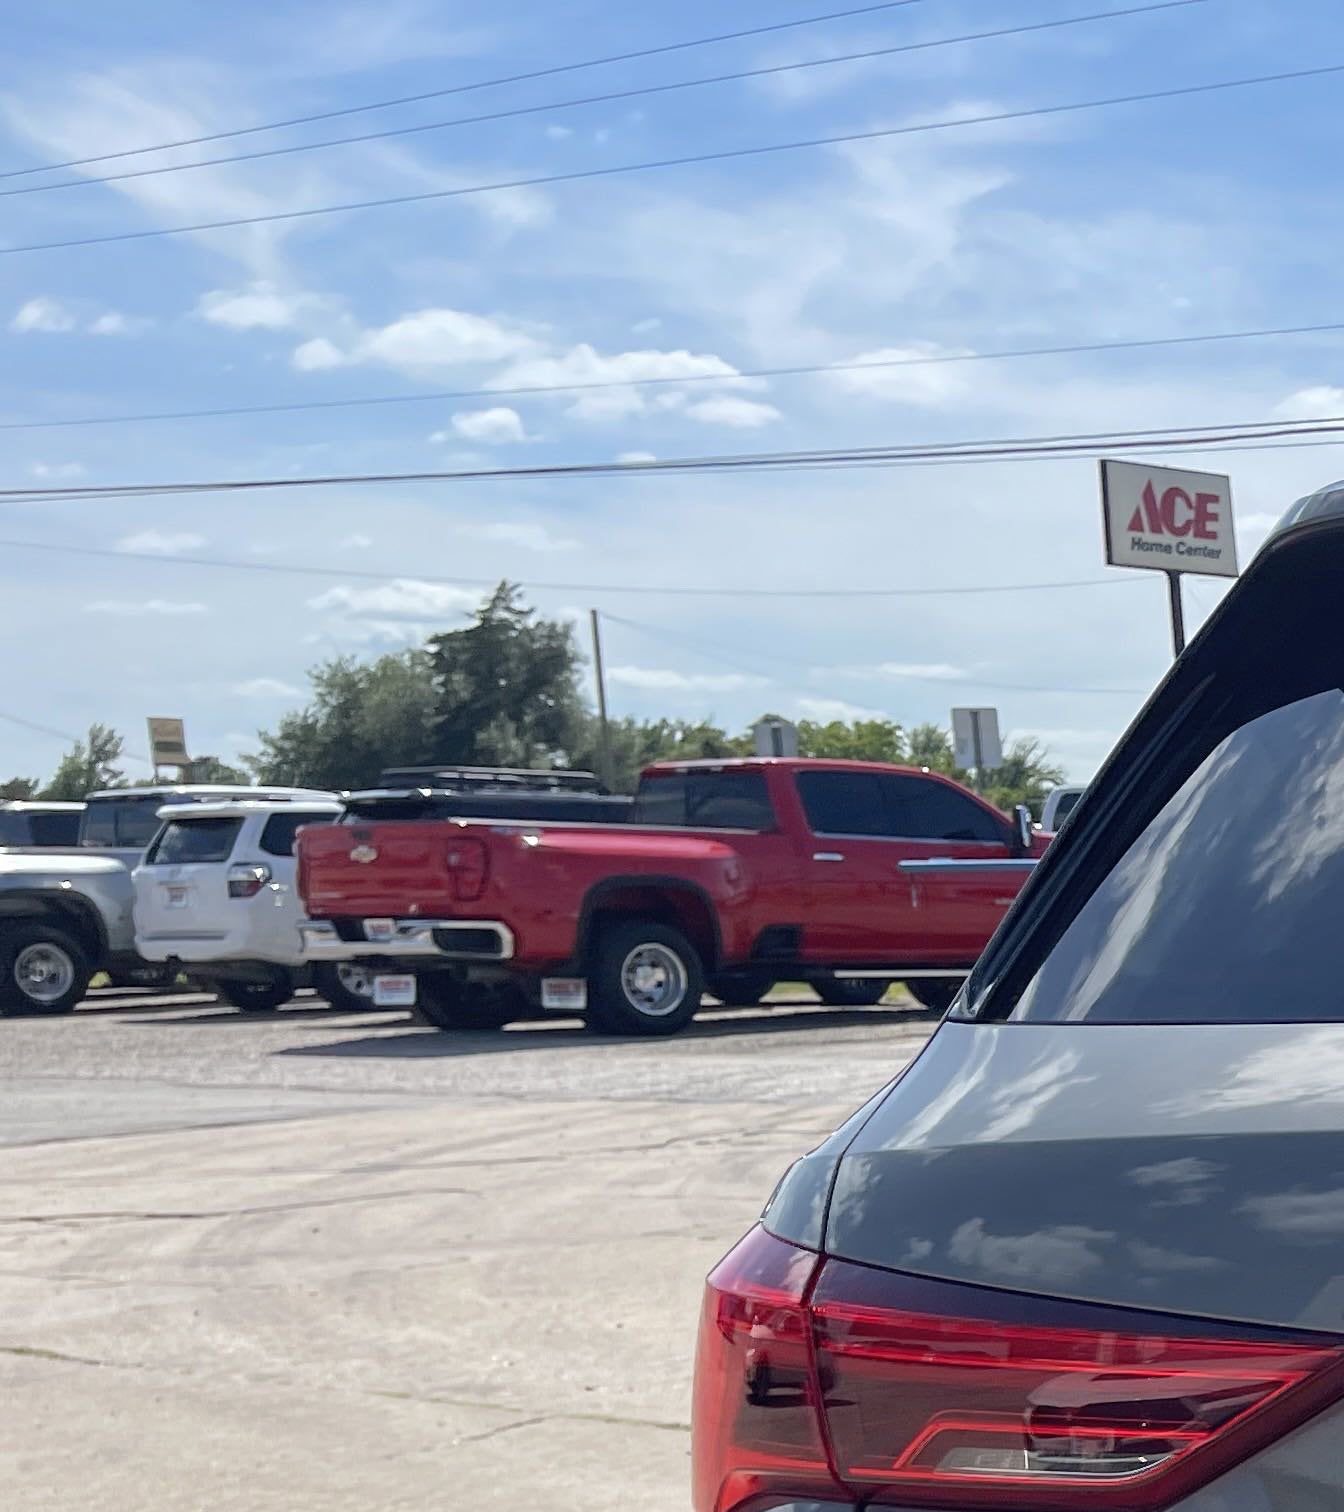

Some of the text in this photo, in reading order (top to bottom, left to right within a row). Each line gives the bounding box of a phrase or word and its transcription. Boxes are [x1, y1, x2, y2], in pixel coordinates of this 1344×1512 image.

[1127, 478, 1220, 540] ACE
[1130, 537, 1222, 559] Home Center
